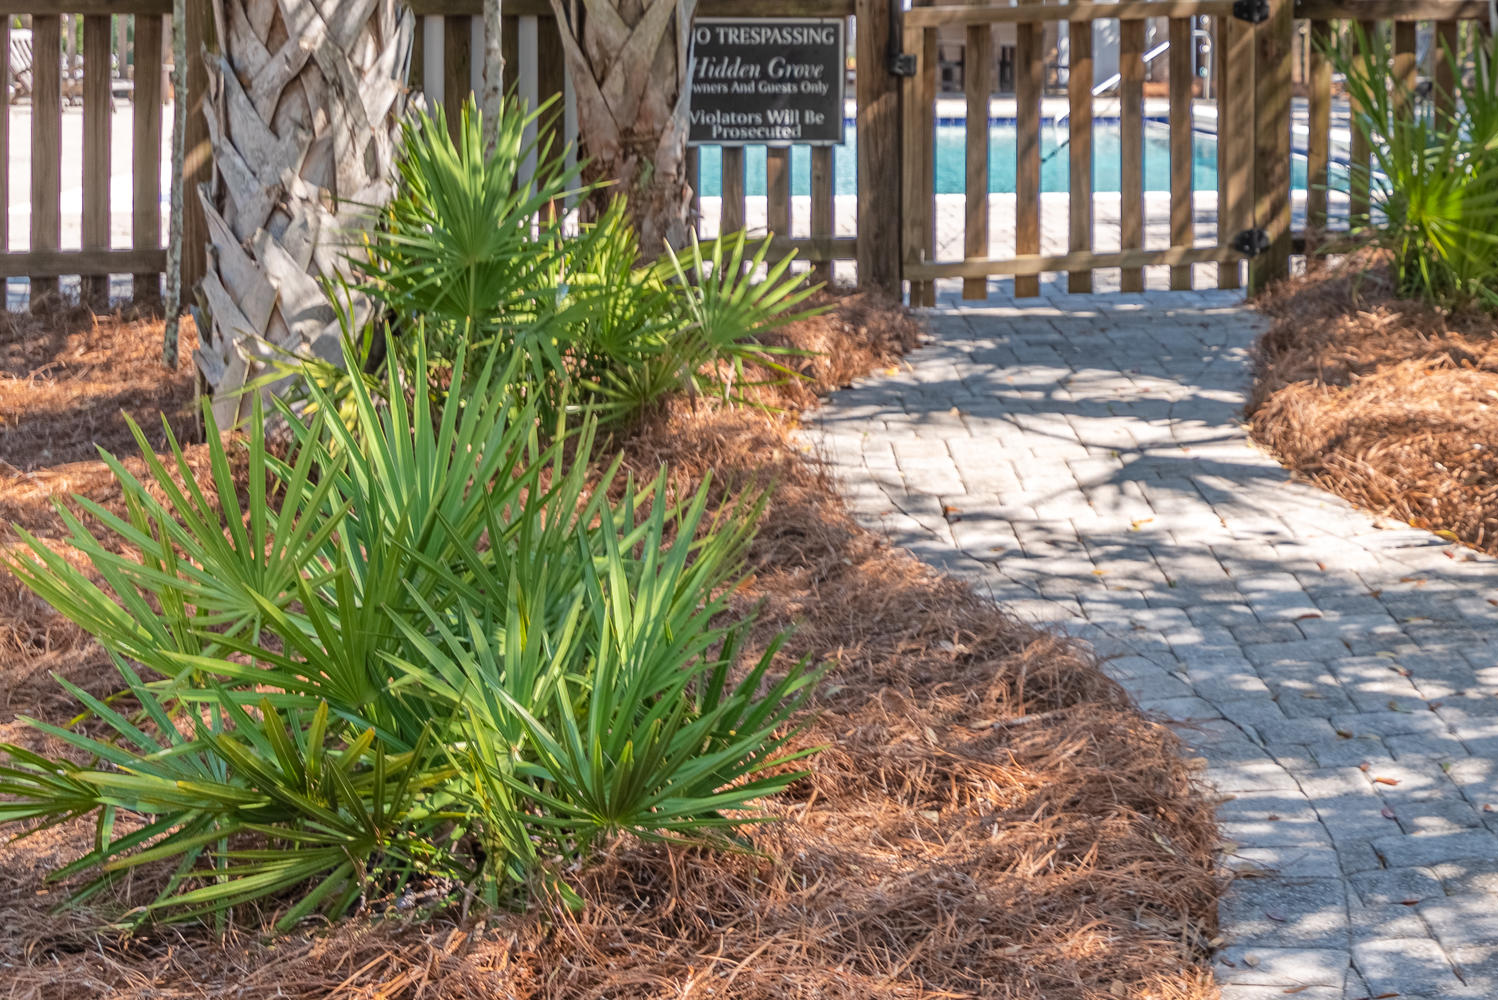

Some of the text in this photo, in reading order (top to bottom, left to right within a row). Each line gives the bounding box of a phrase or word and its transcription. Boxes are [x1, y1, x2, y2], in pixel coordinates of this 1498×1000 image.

[695, 27, 834, 46] O TRESPASSING
[768, 56, 824, 79] Grove
[692, 80, 829, 96] wners And Guests Only
[690, 109, 825, 126] Violators Will Be
[712, 125, 802, 139] Prosecuted
